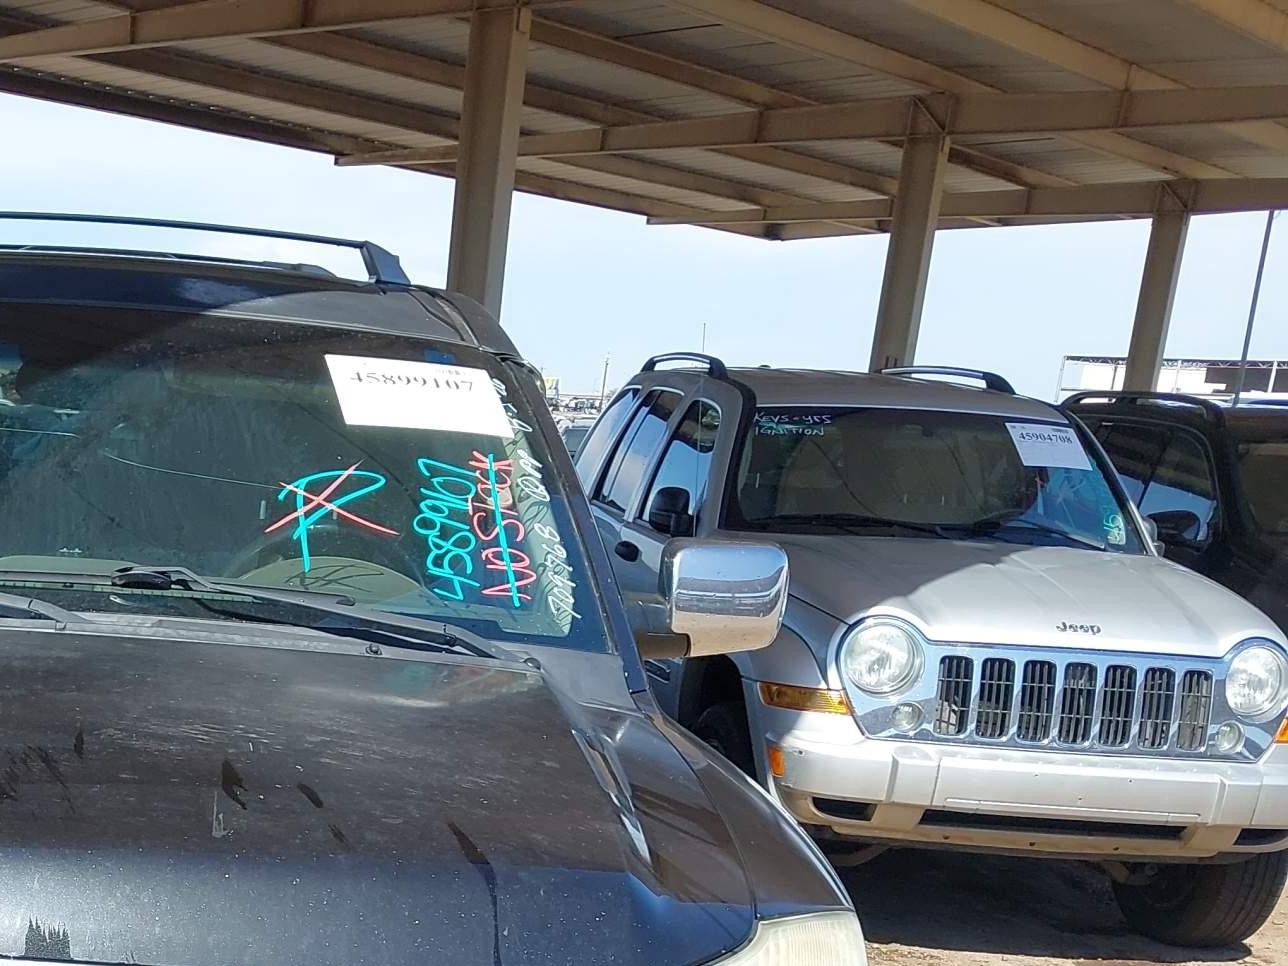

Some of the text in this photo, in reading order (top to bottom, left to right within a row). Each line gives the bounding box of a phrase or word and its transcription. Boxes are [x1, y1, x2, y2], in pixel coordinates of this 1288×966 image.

[755, 425, 824, 436] IGNITION
[1018, 431, 1073, 444] 45904708
[1056, 621, 1101, 635] Jeep
